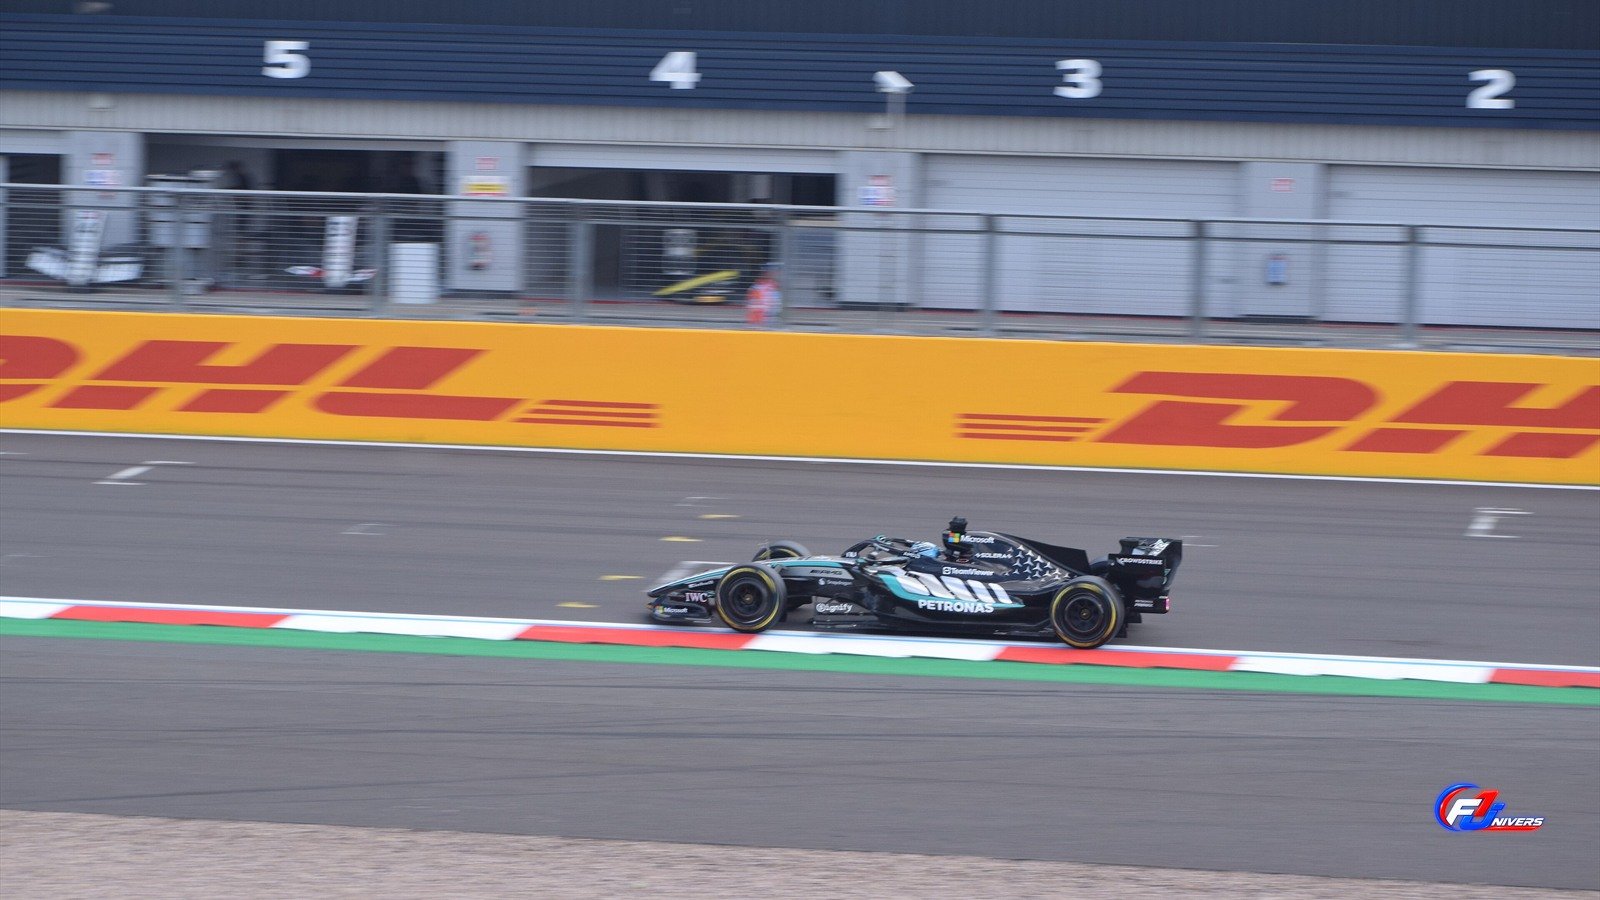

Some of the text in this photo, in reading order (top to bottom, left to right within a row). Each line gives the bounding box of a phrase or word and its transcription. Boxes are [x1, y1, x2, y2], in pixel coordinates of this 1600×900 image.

[261, 40, 311, 79] 5
[649, 51, 701, 89] 4
[1054, 59, 1103, 99] 3
[1466, 69, 1516, 109] 2
[960, 535, 995, 544] Microsoft
[1120, 557, 1163, 565] CROWDSTRIKE
[951, 567, 995, 576] TeamViewer
[685, 592, 708, 603] IWC
[663, 606, 688, 614] Microsoft
[918, 600, 995, 614] PETRONAS
